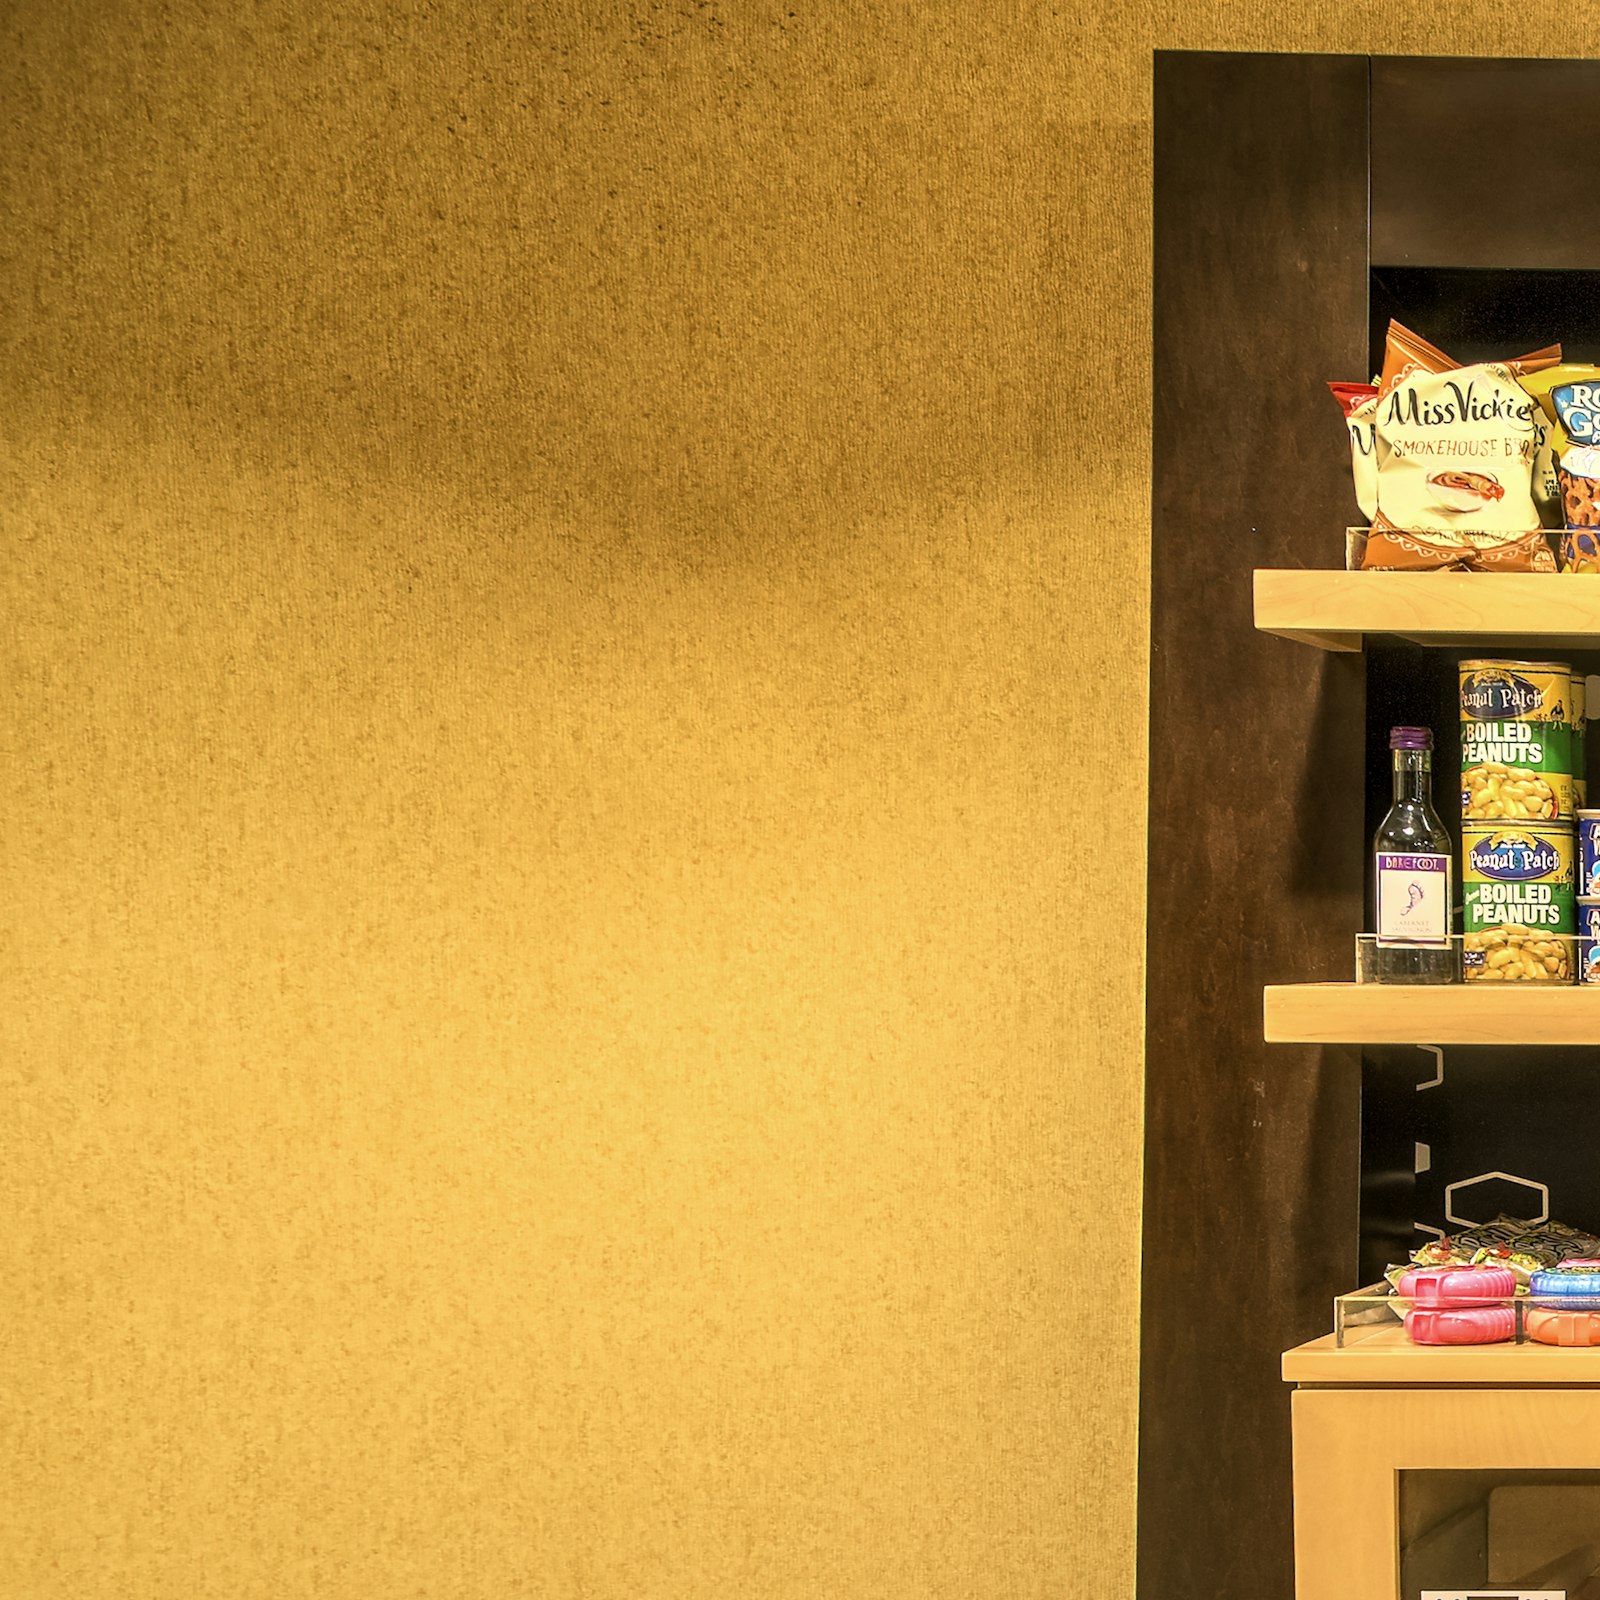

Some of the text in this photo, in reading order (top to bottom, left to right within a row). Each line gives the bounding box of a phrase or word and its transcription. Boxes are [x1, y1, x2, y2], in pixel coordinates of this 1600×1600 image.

[1393, 438, 1497, 458] SMOKEHOUSE
[1469, 850, 1561, 870] Peanut Patch
[1480, 884, 1551, 904] BOILED
[1473, 904, 1560, 924] PEANUTS
